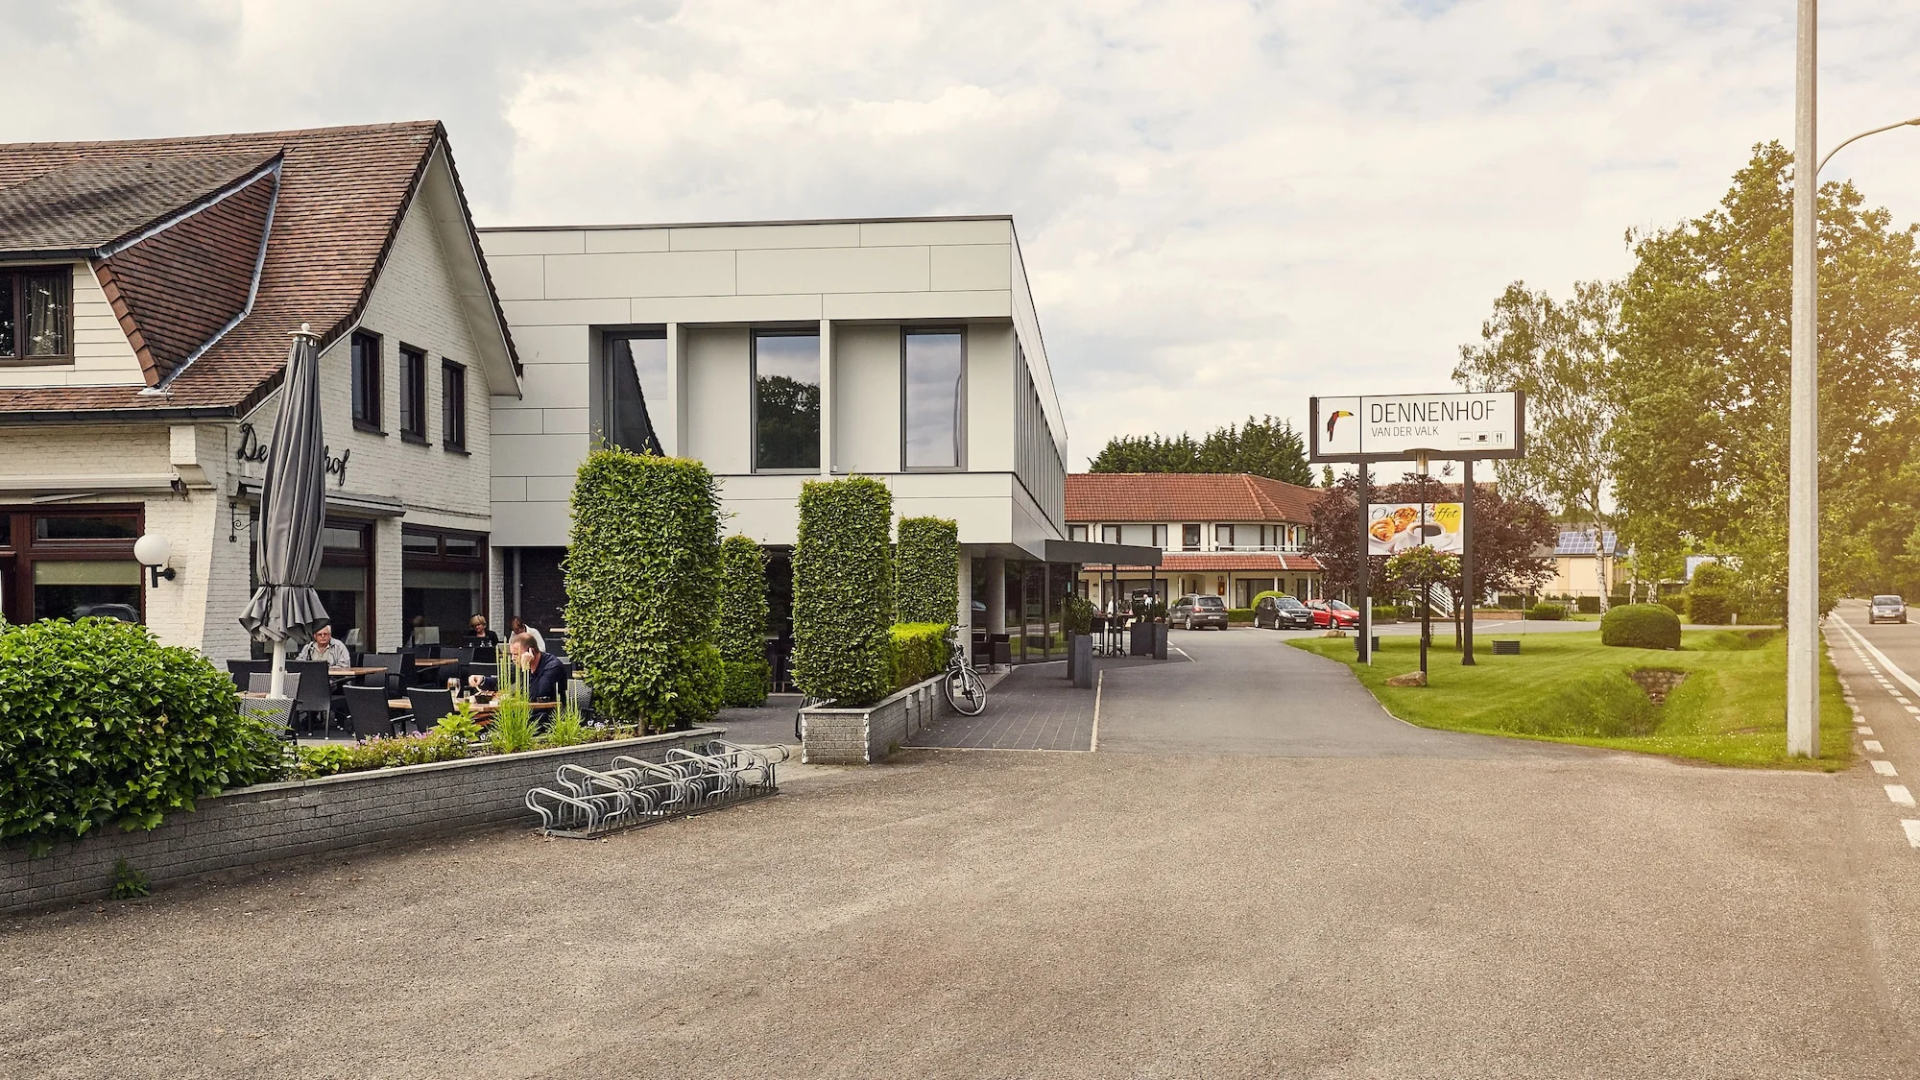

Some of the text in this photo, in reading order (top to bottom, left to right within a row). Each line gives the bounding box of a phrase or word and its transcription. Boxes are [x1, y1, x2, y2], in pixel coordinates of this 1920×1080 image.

[1371, 399, 1497, 423] DENNENHOF
[1371, 425, 1440, 438] VAN DER VALK
[237, 423, 351, 487] Dehof
